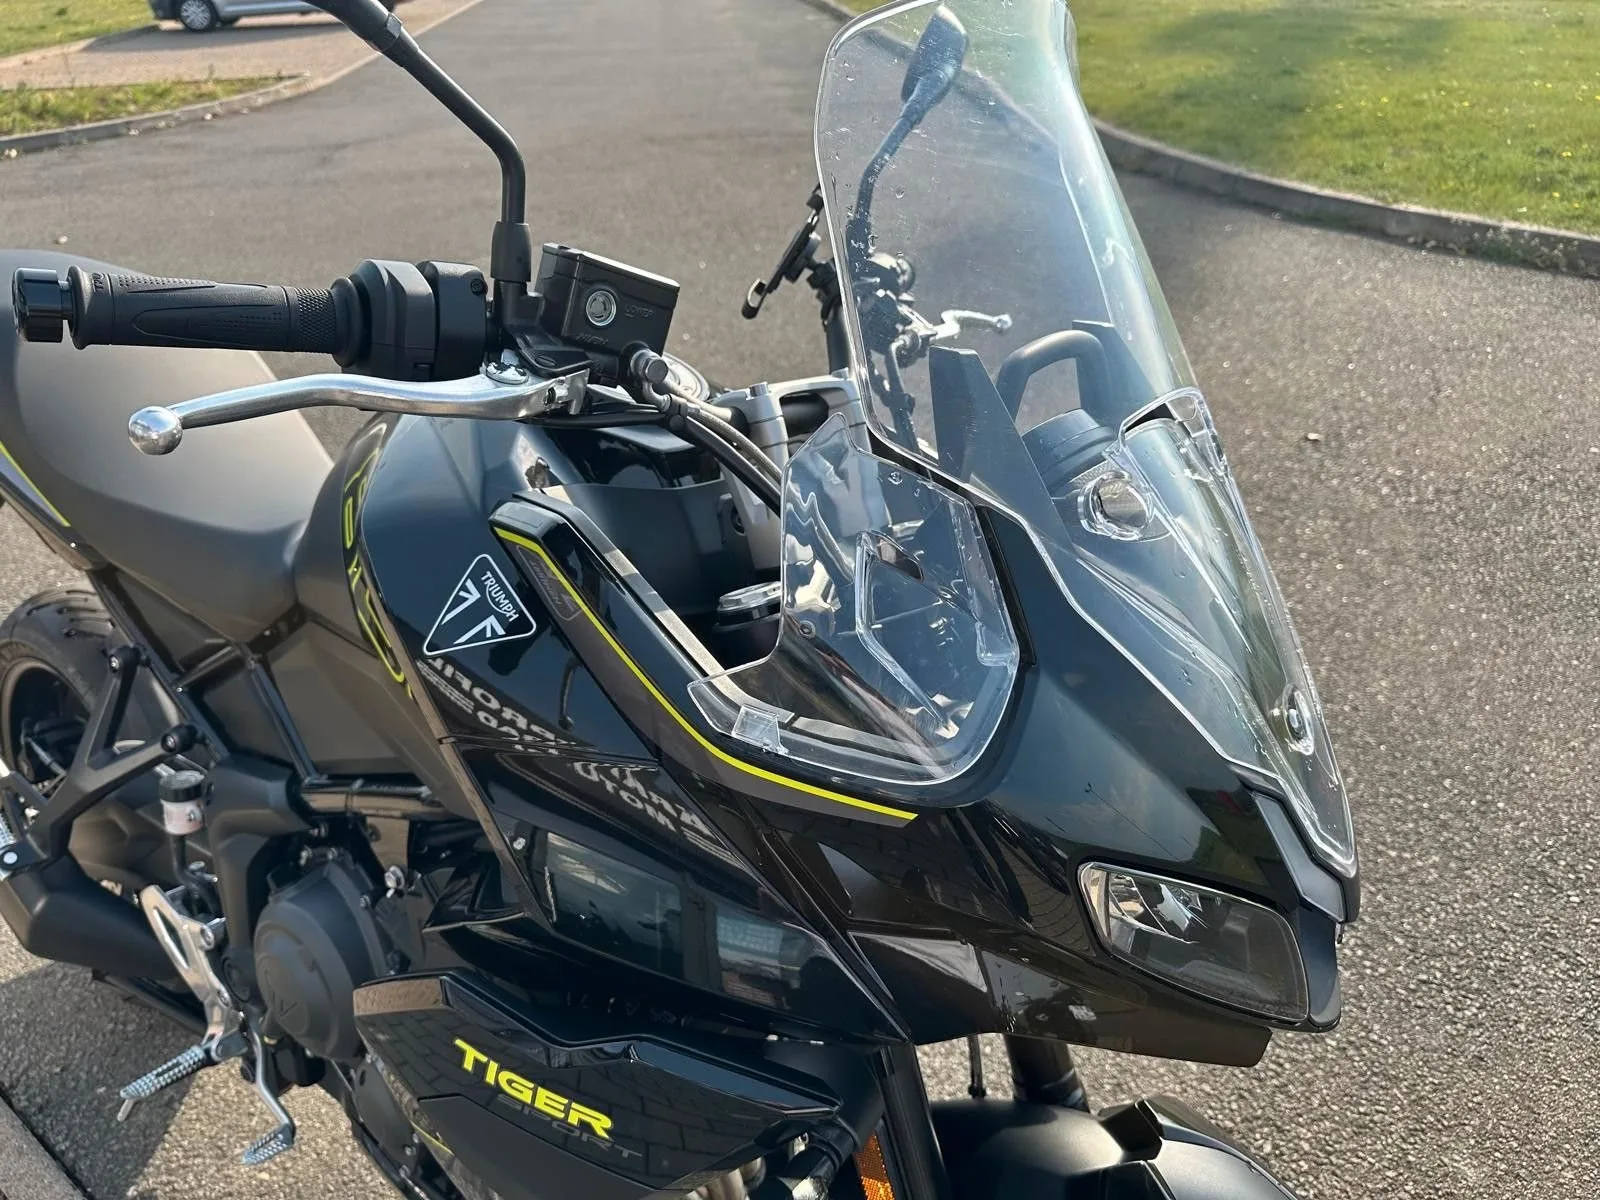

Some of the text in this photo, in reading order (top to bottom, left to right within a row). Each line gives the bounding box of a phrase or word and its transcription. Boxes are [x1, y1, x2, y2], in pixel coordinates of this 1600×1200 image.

[481, 571, 520, 622] TRIUMPH
[454, 1038, 612, 1139] TIGER
[497, 1093, 643, 1158] SPORT
